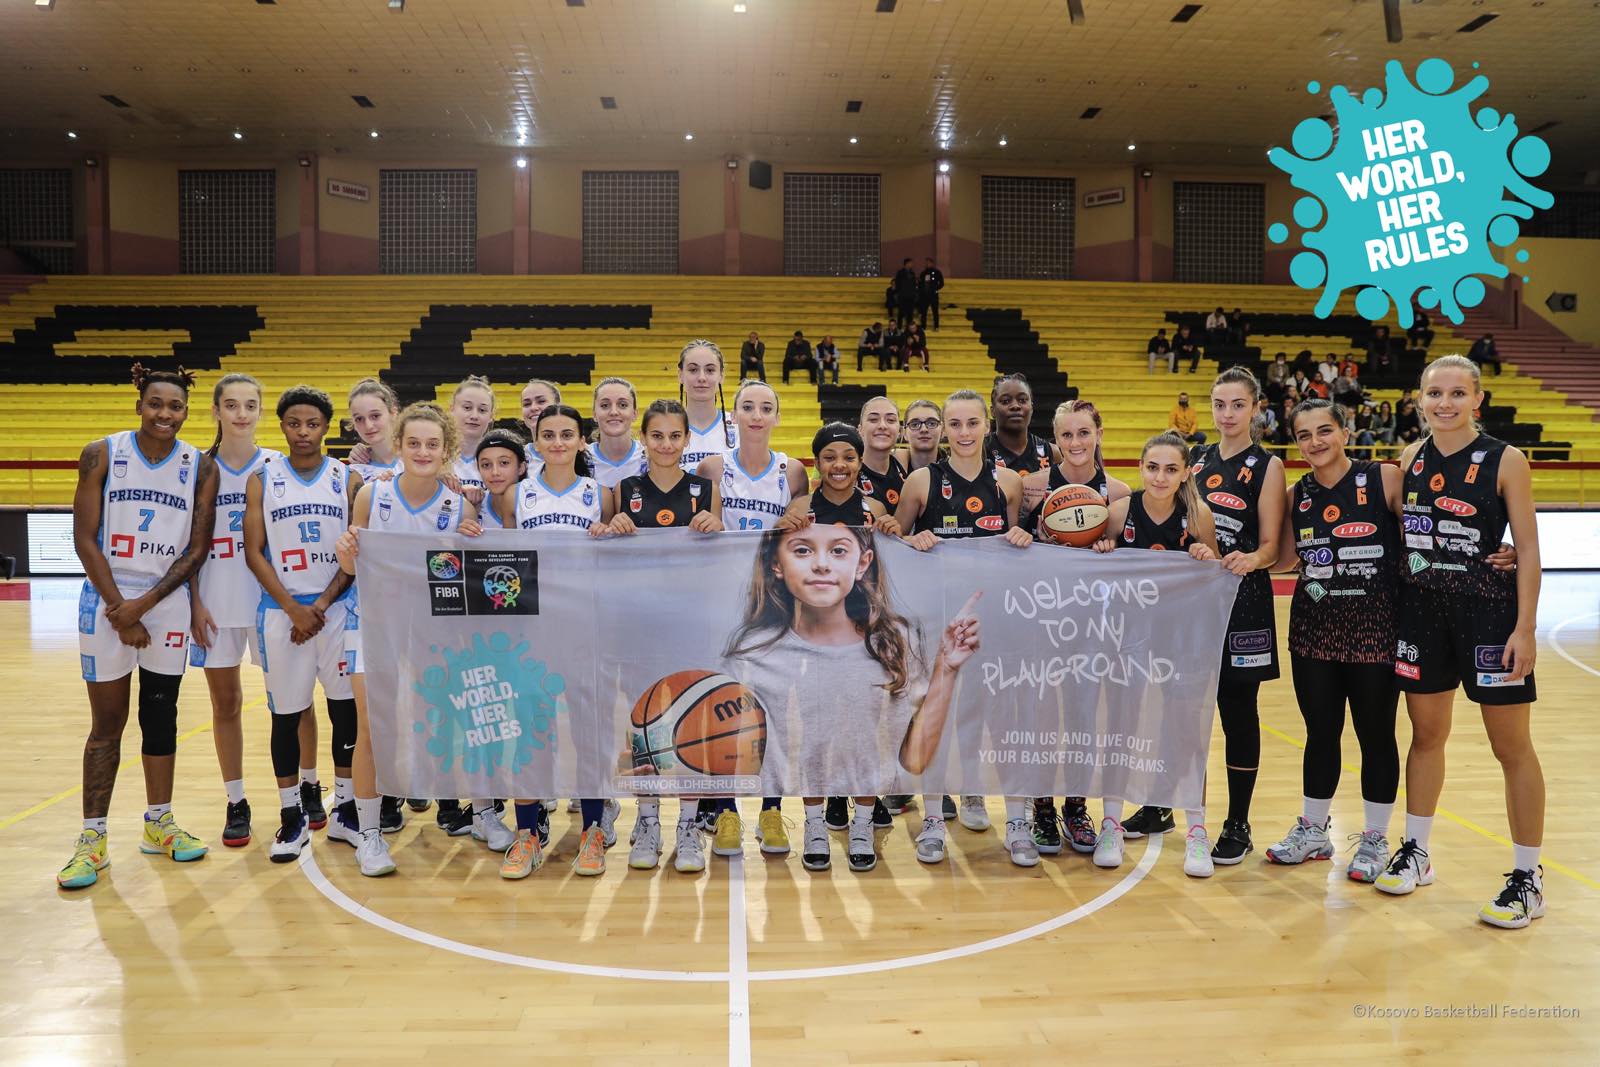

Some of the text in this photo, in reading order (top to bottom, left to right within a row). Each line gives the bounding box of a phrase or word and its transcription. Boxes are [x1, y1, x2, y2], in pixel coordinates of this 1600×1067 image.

[1464, 464, 1480, 484] 8
[109, 489, 188, 511] PRISHTINA
[1356, 487, 1367, 505] 6
[139, 509, 156, 531] 7
[270, 503, 343, 522] PRISHTINA
[983, 519, 1004, 527] LIR
[298, 521, 321, 543] 15
[140, 542, 176, 557] PIKA
[435, 587, 460, 598] FIBA
[1038, 616, 1078, 648] TO
[460, 664, 498, 688] HER
[470, 703, 508, 729] HER
[465, 719, 522, 748] RULES
[1001, 730, 1153, 753] JOIN US AND LIVE OUT
[978, 749, 1168, 774] YOUR BASKETBALL DREAMS.
[617, 778, 757, 791] #HERWORLDHERRULES
